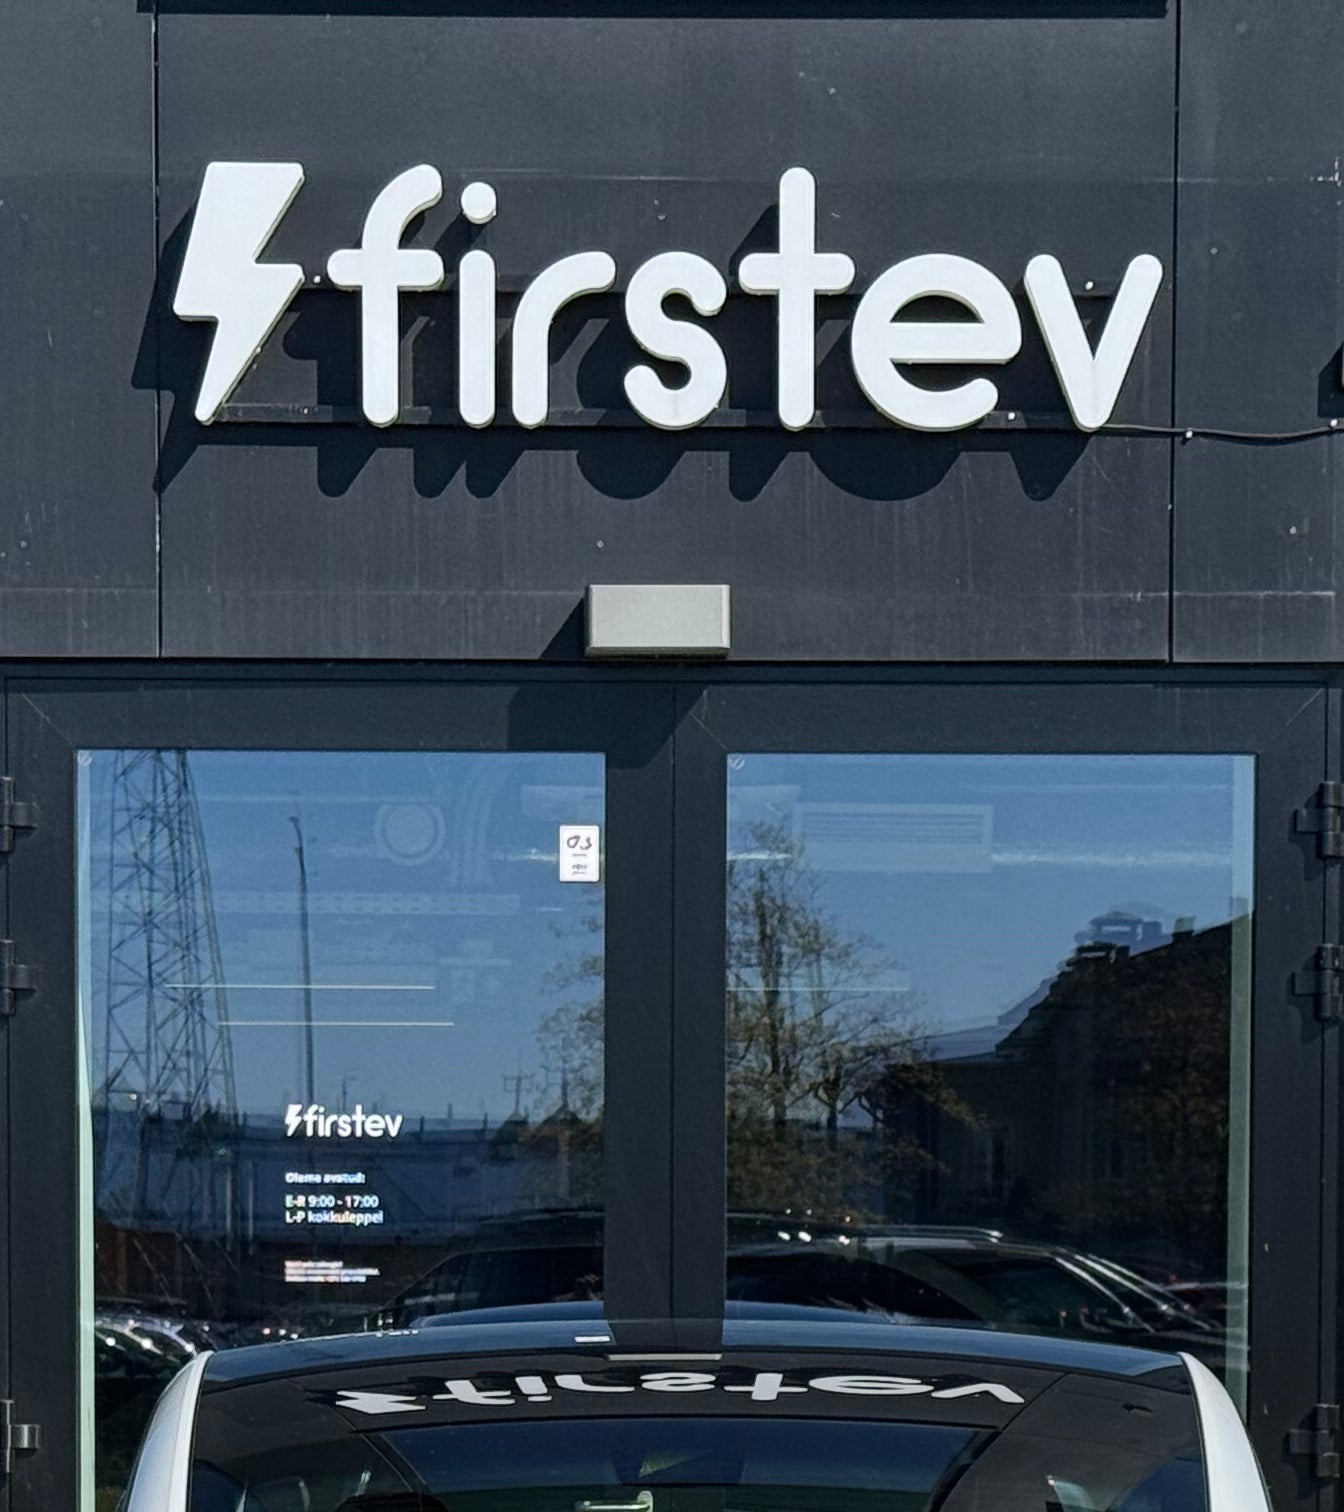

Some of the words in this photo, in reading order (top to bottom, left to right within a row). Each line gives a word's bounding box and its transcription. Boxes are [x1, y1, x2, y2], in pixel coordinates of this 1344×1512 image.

[325, 163, 1164, 430] firstev
[302, 1103, 403, 1138] firstev
[308, 1194, 336, 1208] 9:00
[344, 1194, 380, 1208] 17:00
[285, 1210, 306, 1224] L-P
[307, 1210, 384, 1227] kokkuleppel
